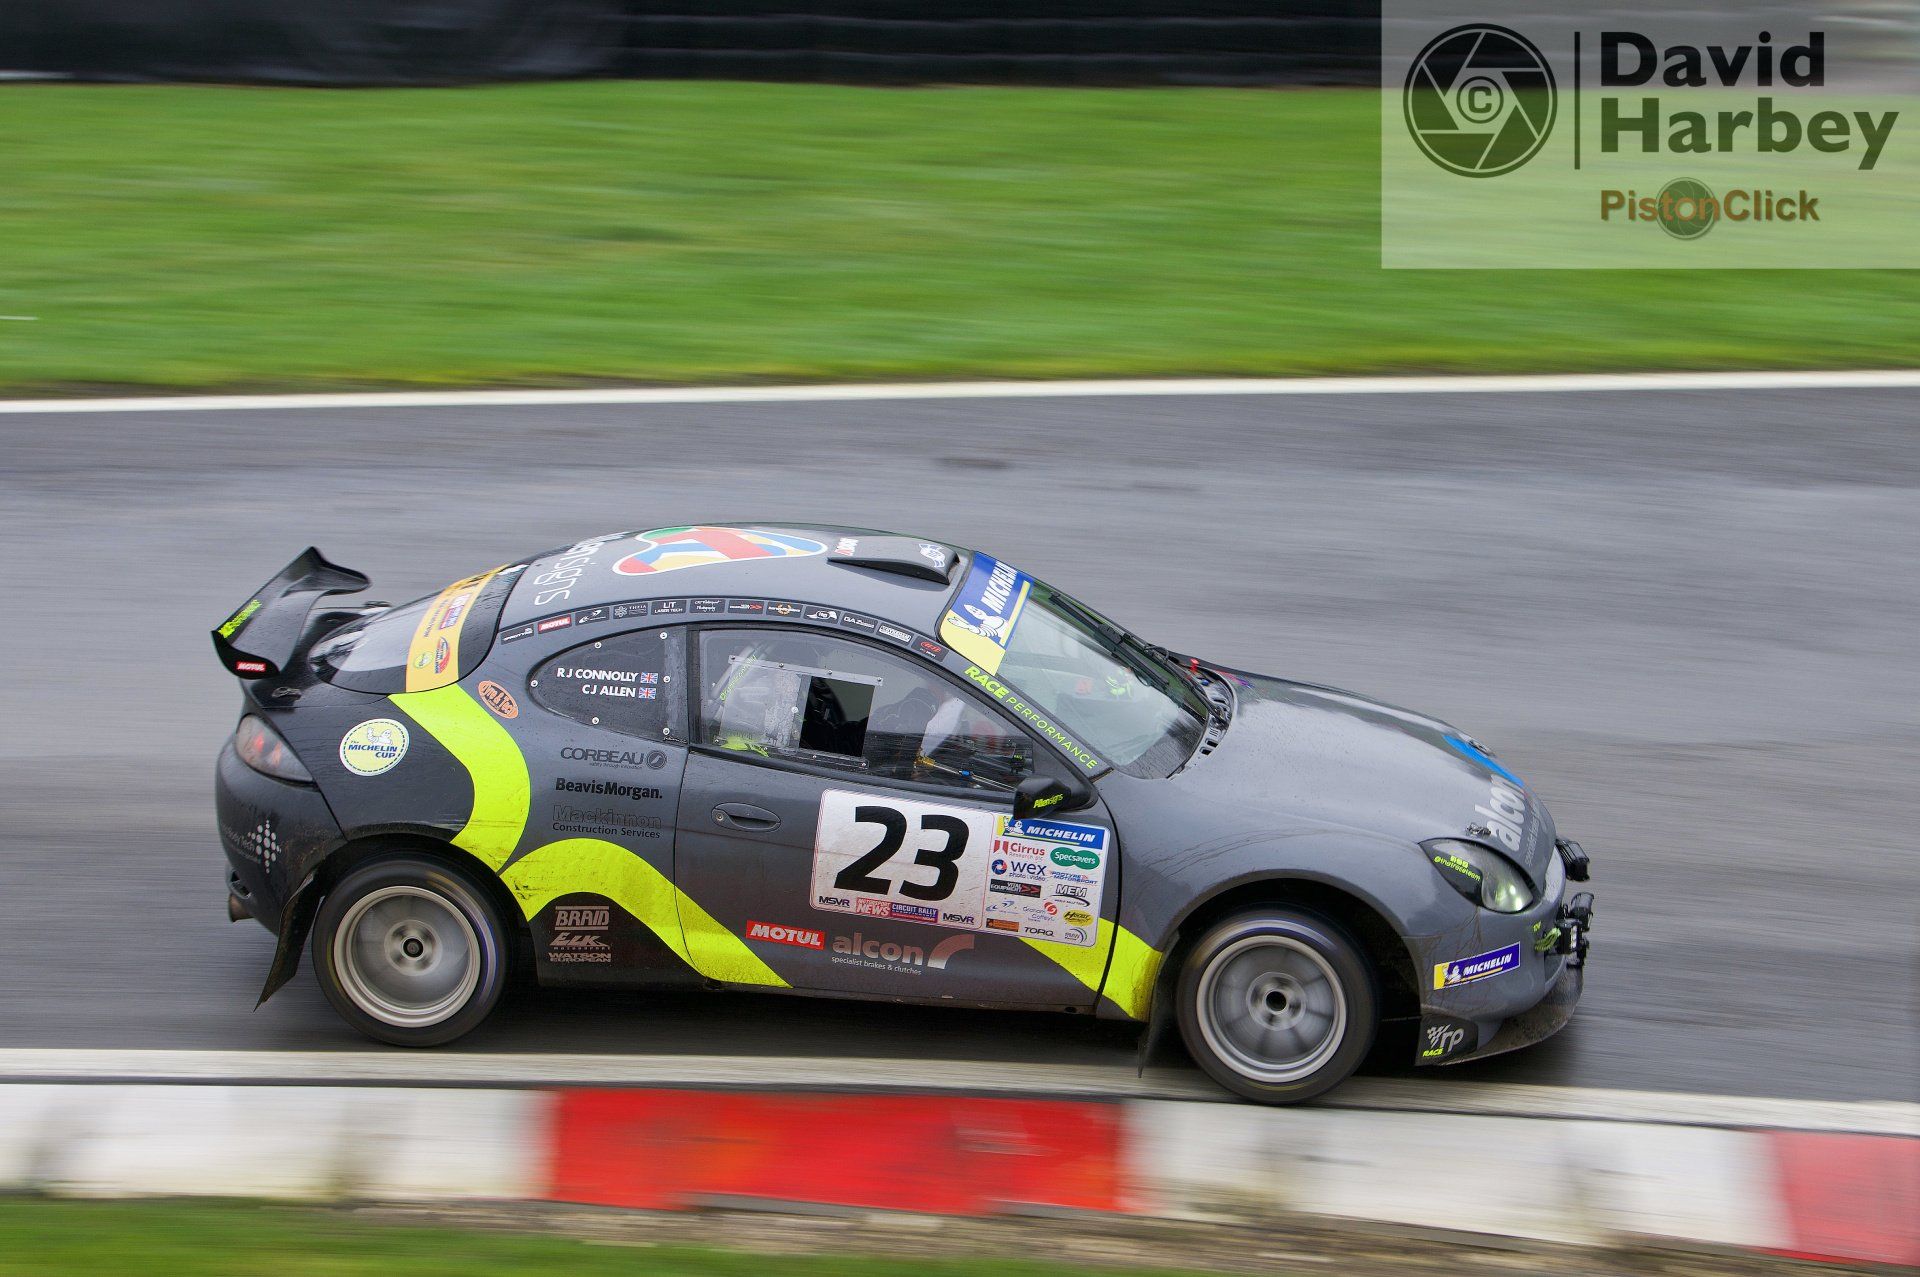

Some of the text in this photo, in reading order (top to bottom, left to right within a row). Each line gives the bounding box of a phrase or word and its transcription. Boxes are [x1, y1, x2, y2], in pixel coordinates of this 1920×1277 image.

[556, 667, 565, 678] R
[575, 669, 639, 683] CONNOLLY
[600, 685, 637, 698] ALLEN
[964, 665, 1098, 770] RACE PERFORMANCE
[348, 744, 398, 752] MICHELIN
[375, 751, 397, 759] CUP
[560, 746, 645, 765] CORBEAU
[554, 777, 664, 800] BeavisMorgan.
[552, 804, 662, 830] Mackinnon
[552, 822, 661, 839] Construction Services
[1025, 825, 1096, 843] MICHELIN
[833, 805, 970, 902] 23
[1010, 842, 1046, 856] Cirrus
[1054, 851, 1096, 865] Specsavers
[1010, 860, 1047, 877] wex
[818, 895, 851, 907] MSVR
[891, 903, 917, 913] CIRCUIT
[918, 907, 937, 915] RALLY
[555, 910, 610, 926] BRAID
[856, 903, 891, 917] NEWS
[942, 912, 975, 924] MSVR
[750, 924, 821, 946] MOTUL
[1024, 926, 1055, 937] TORQ
[832, 932, 923, 966] alcon
[831, 956, 922, 976] specialist brakes & clutches
[1462, 952, 1513, 977] MICHELIN
